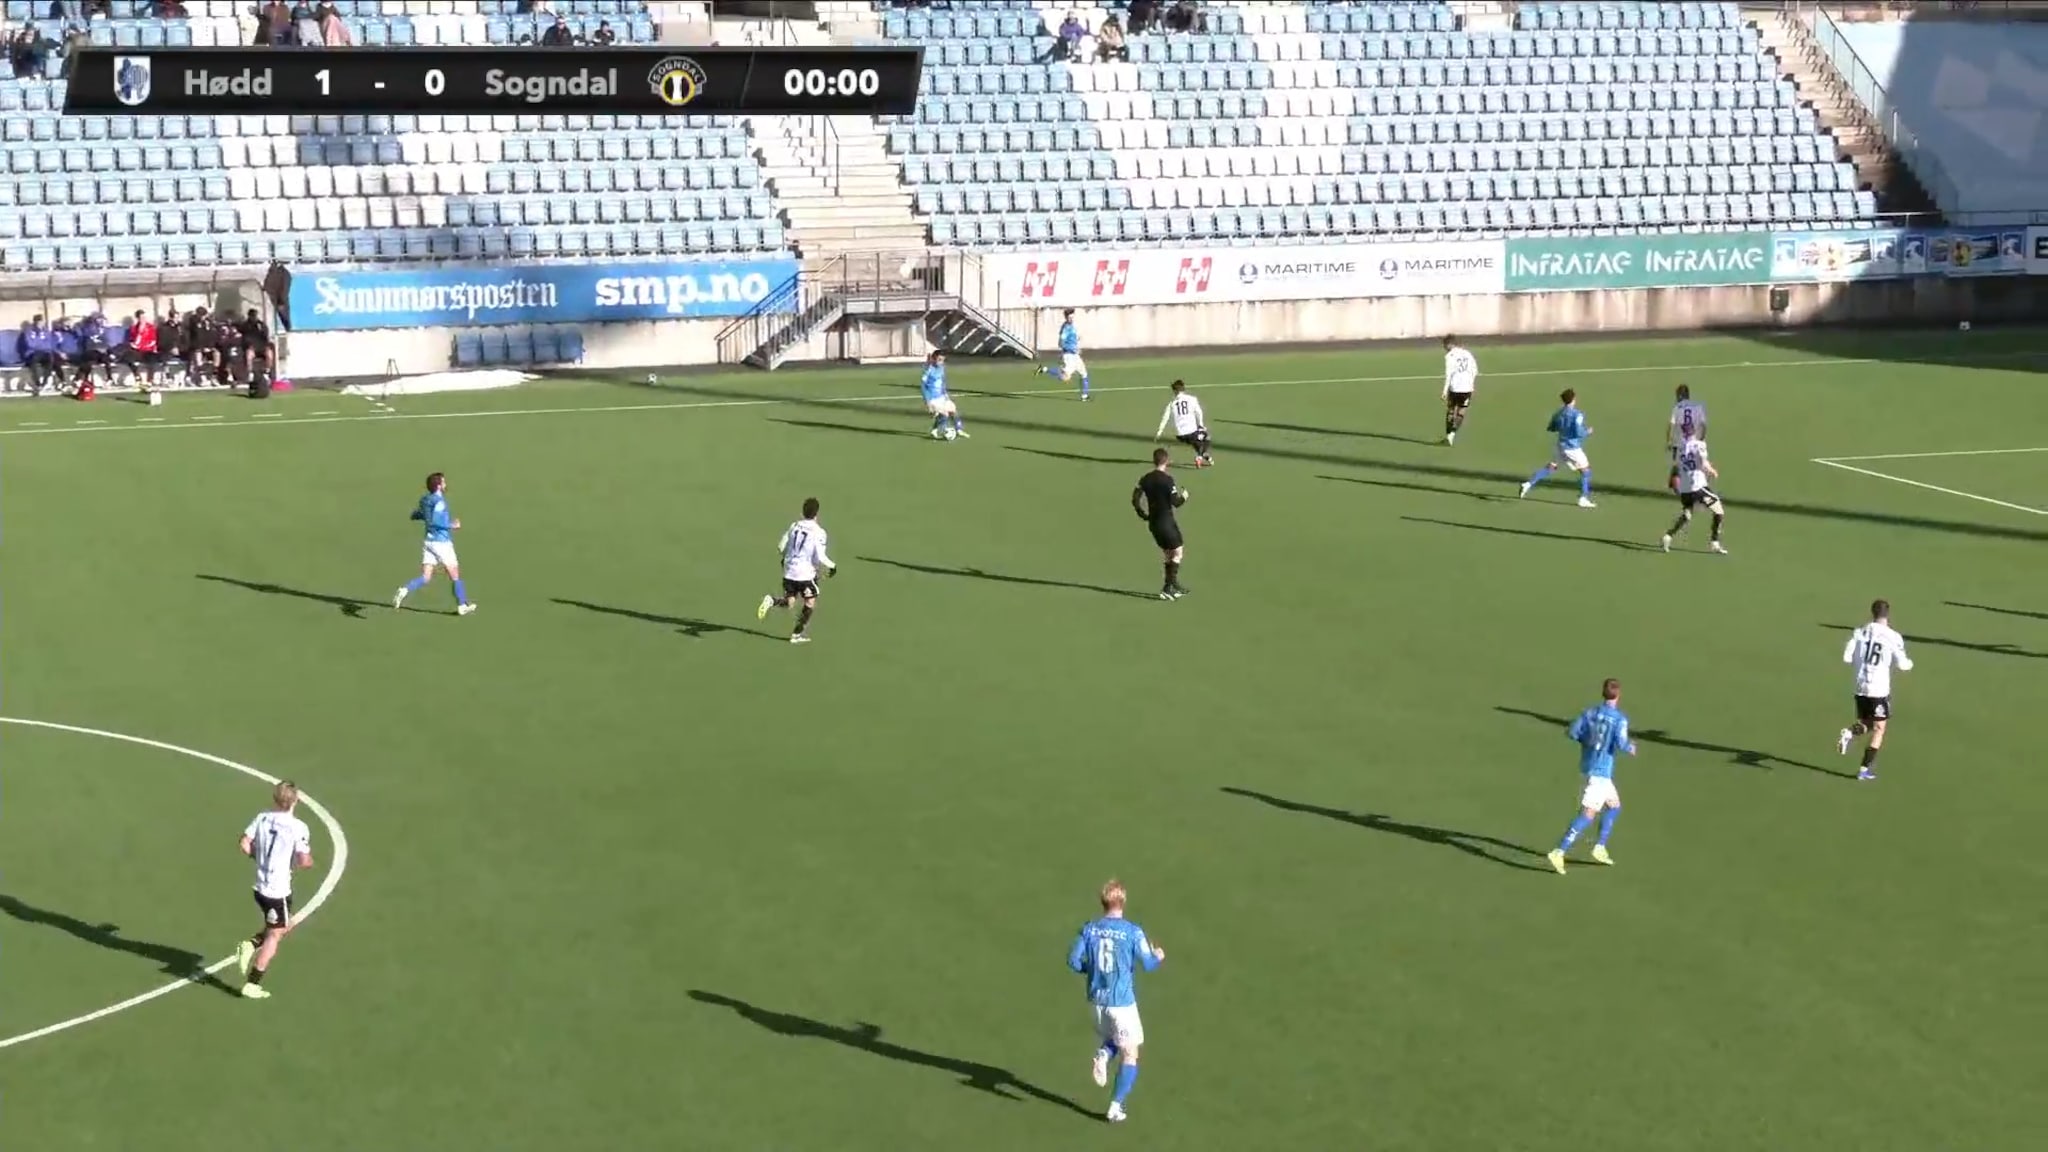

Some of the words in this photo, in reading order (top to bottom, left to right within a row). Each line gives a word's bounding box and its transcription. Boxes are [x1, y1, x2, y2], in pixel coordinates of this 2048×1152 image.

[1264, 261, 1357, 275] MARITIME
[1404, 257, 1495, 271] MARITIME
[595, 270, 770, 313] smp.no
[1175, 400, 1189, 416] 18
[793, 529, 808, 552] 17
[1864, 641, 1882, 666] 16
[268, 829, 277, 857] 7
[1098, 938, 1114, 974] 6
